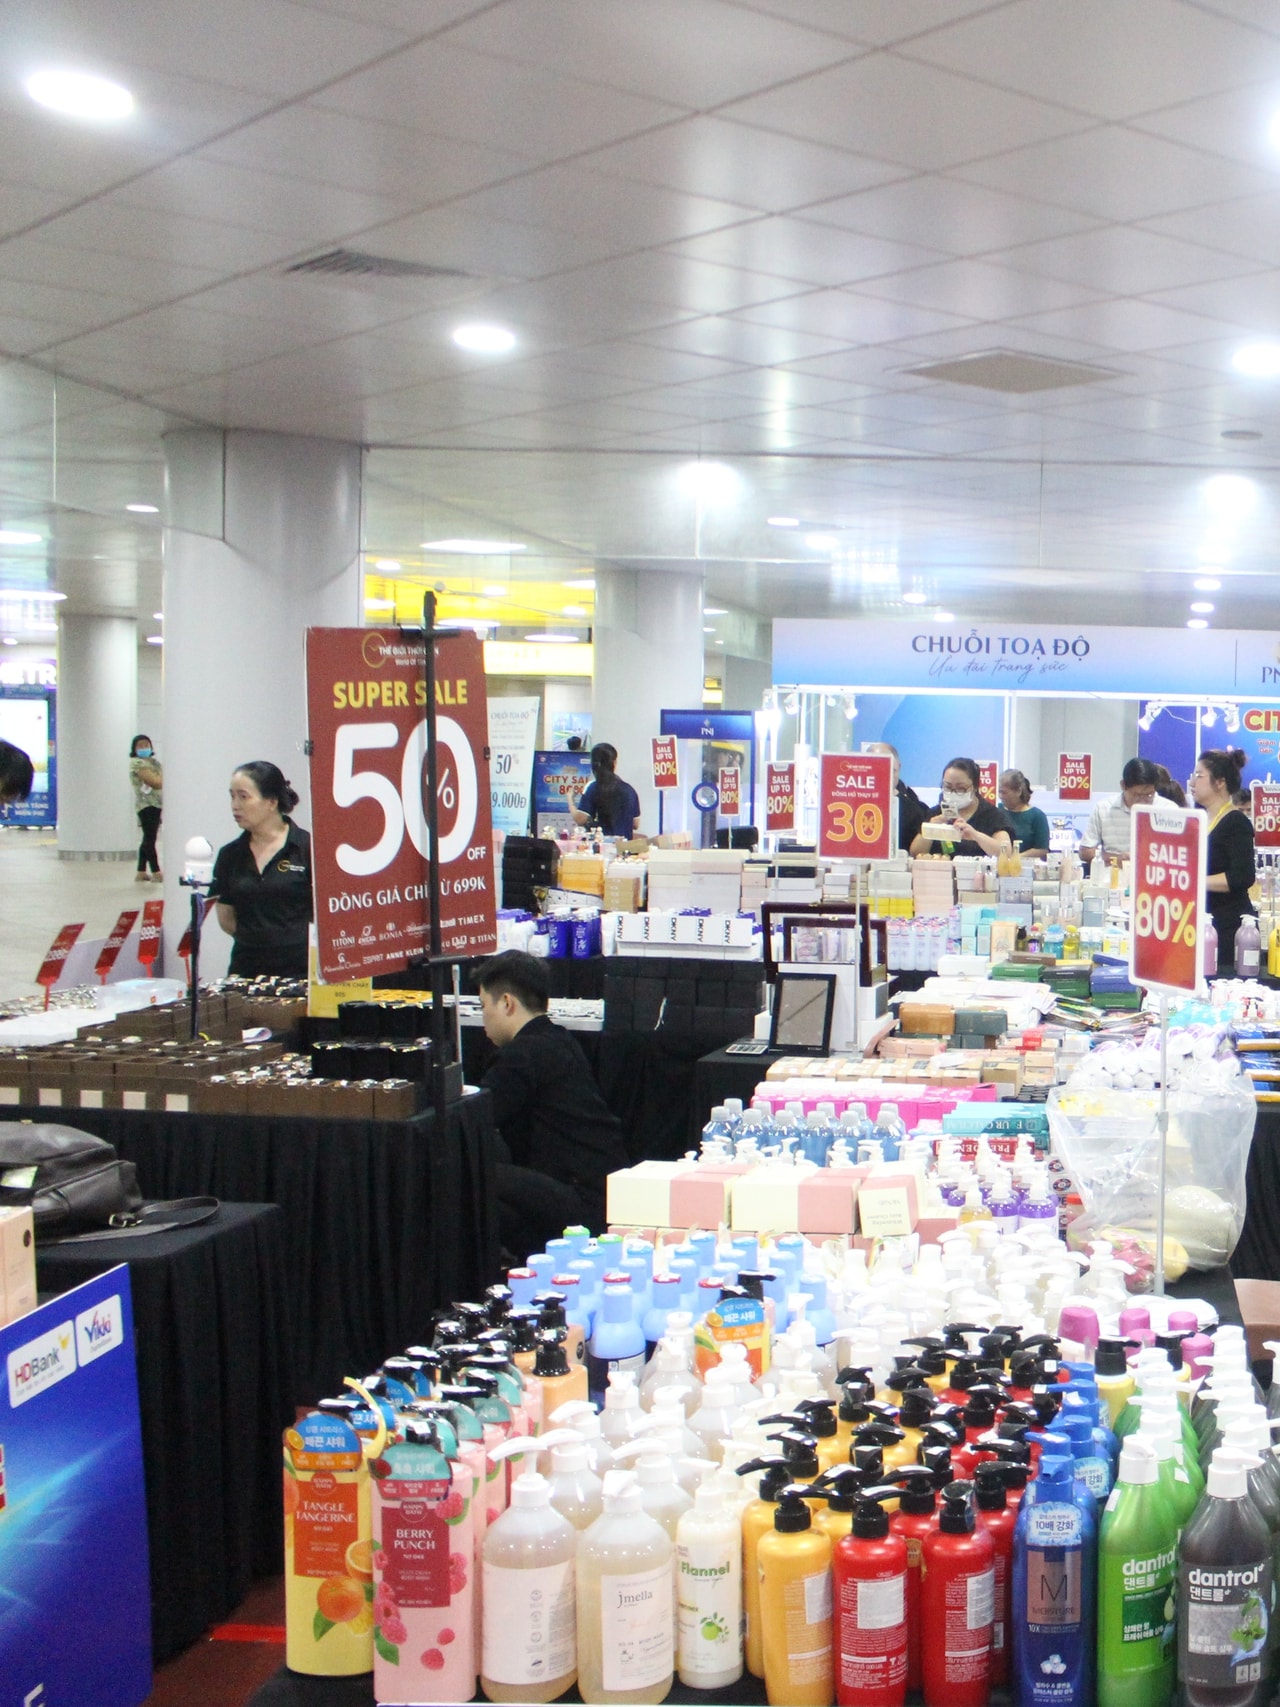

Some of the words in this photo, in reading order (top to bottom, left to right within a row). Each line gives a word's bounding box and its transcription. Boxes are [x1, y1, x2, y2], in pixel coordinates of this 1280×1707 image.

[912, 629, 991, 654] CHUỖI
[998, 637, 1046, 660] TOẠ
[1053, 635, 1090, 661] ĐỘ
[333, 680, 410, 710] SUPER
[414, 679, 468, 706] SALE
[701, 727, 714, 736] PNJ
[665, 752, 673, 760] TO
[495, 754, 511, 774] 50
[654, 761, 676, 776] 80%
[543, 775, 568, 784] CITY
[772, 775, 789, 784] SALE
[836, 774, 875, 789] SALE
[1060, 776, 1089, 789] 80%
[333, 714, 478, 876] 50
[771, 785, 780, 793] UP
[781, 784, 791, 793] TO
[721, 791, 739, 804] 80%
[767, 797, 794, 815] 80%
[1260, 805, 1273, 813] UP
[826, 801, 883, 844] 30
[466, 846, 487, 861] OFF
[1149, 842, 1187, 867] SALE
[1145, 866, 1166, 886] UP
[1169, 868, 1190, 891] TO
[328, 891, 373, 914] ĐỒNG
[404, 883, 428, 902] CHỈ
[453, 876, 487, 894] 699K
[457, 914, 485, 926] TIMEX
[1135, 892, 1196, 947] 80%
[332, 936, 355, 947] TITONI
[477, 933, 497, 943] TITAN
[363, 954, 384, 965] ESPRIT
[386, 951, 404, 961] ANNE
[405, 948, 424, 957] KLEIN
[84, 1310, 111, 1343] Vikki
[14, 1347, 60, 1387] HDBank
[326, 1436, 346, 1448] 샤워
[302, 1501, 345, 1512] TANGLE
[296, 1512, 355, 1523] TANGERINE
[1035, 1521, 1054, 1531] 10배
[1056, 1520, 1074, 1532] 강화
[396, 1529, 435, 1539] BERRY
[394, 1540, 435, 1550] PUNCH
[1122, 1546, 1176, 1576] dantrol
[681, 1561, 730, 1577] Flannel
[1124, 1574, 1156, 1591] 댄트롤
[1188, 1566, 1258, 1588] dantrol
[1041, 1574, 1068, 1601] M
[1190, 1586, 1224, 1602] 댄트롤
[617, 1590, 653, 1609] jmella
[1028, 1624, 1041, 1633] 10X
